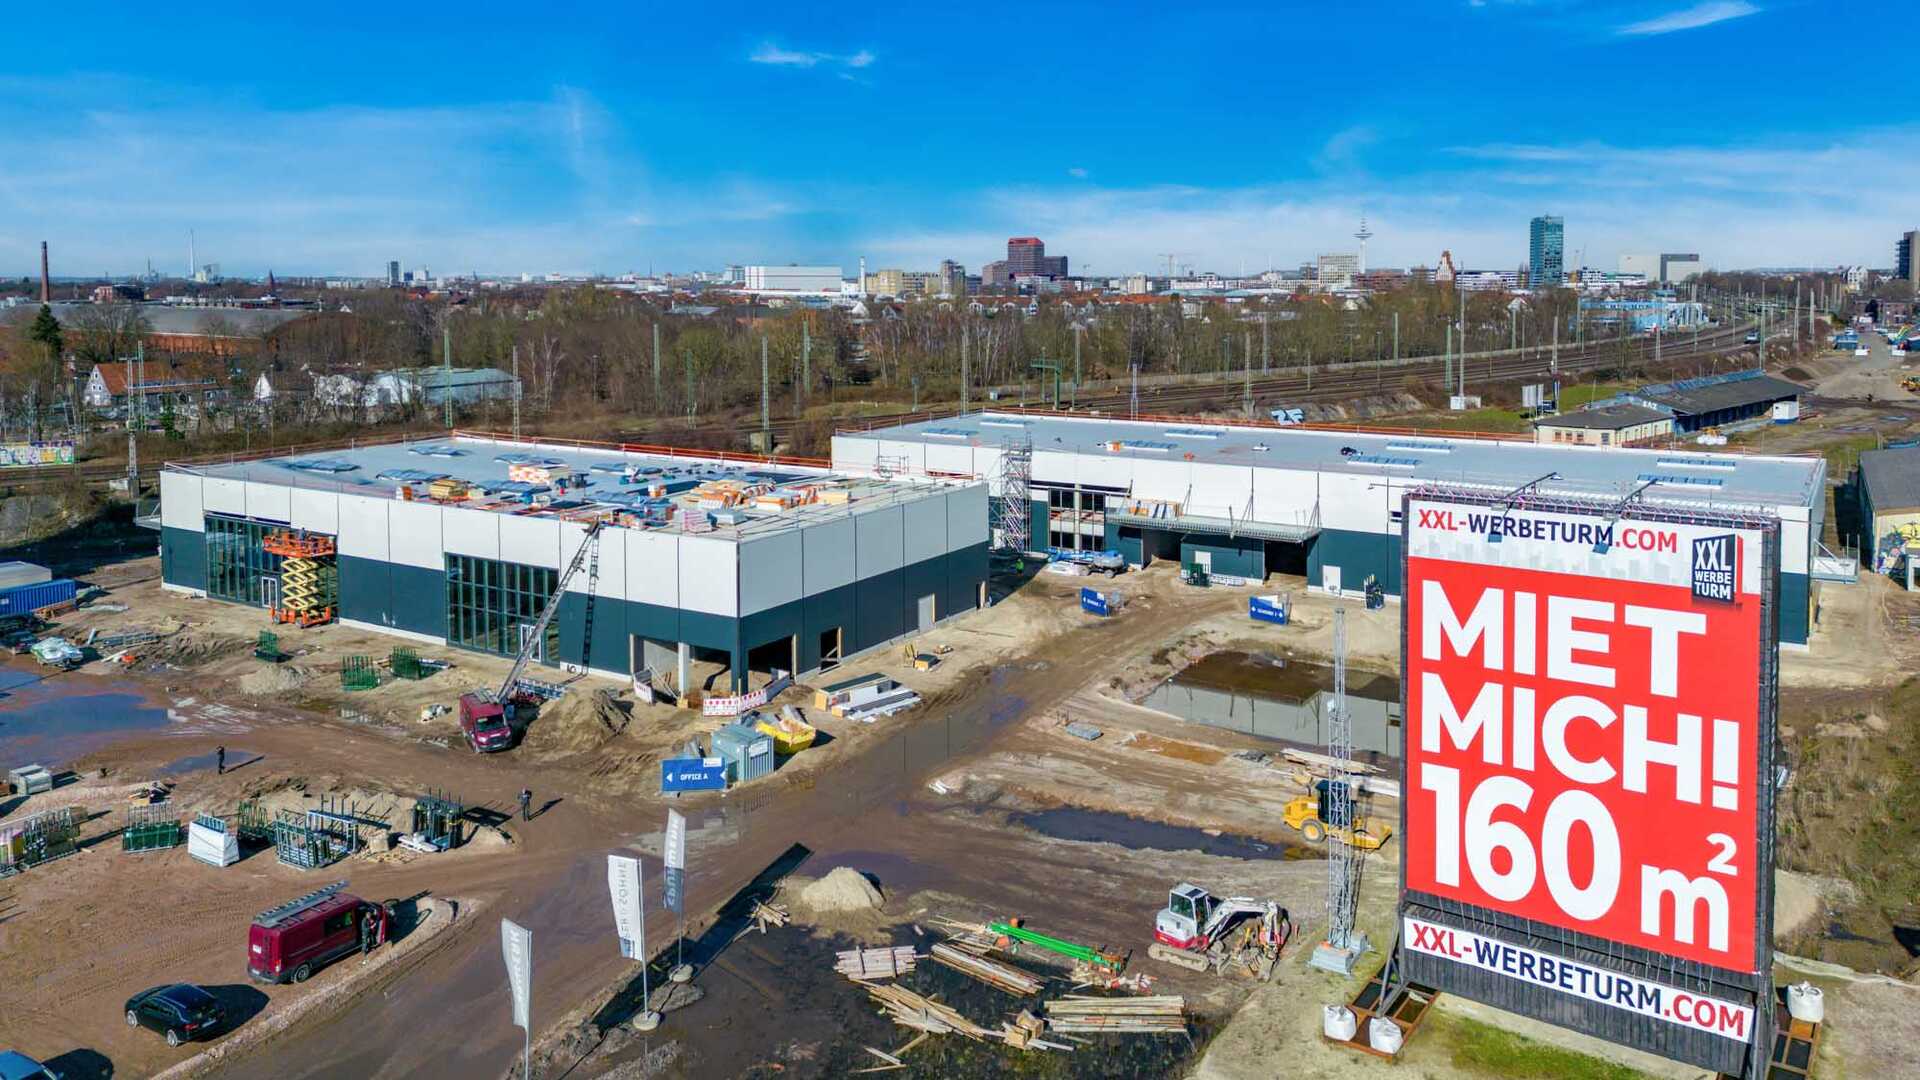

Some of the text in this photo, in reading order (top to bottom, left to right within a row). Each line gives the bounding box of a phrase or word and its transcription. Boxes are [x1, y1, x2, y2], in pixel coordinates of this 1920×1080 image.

[1418, 508, 1678, 554] XXL-WERBETURM.COM
[1695, 538, 1732, 571] XXL
[1694, 571, 1732, 585] WERBE
[1694, 582, 1731, 600] TURM
[1422, 580, 1707, 698] MIET
[1421, 671, 1740, 811] MICH!
[679, 773, 703, 781] OFFICE
[1421, 762, 1621, 921] 160
[1411, 922, 1745, 1037] XXL-WERBETURM.COM
